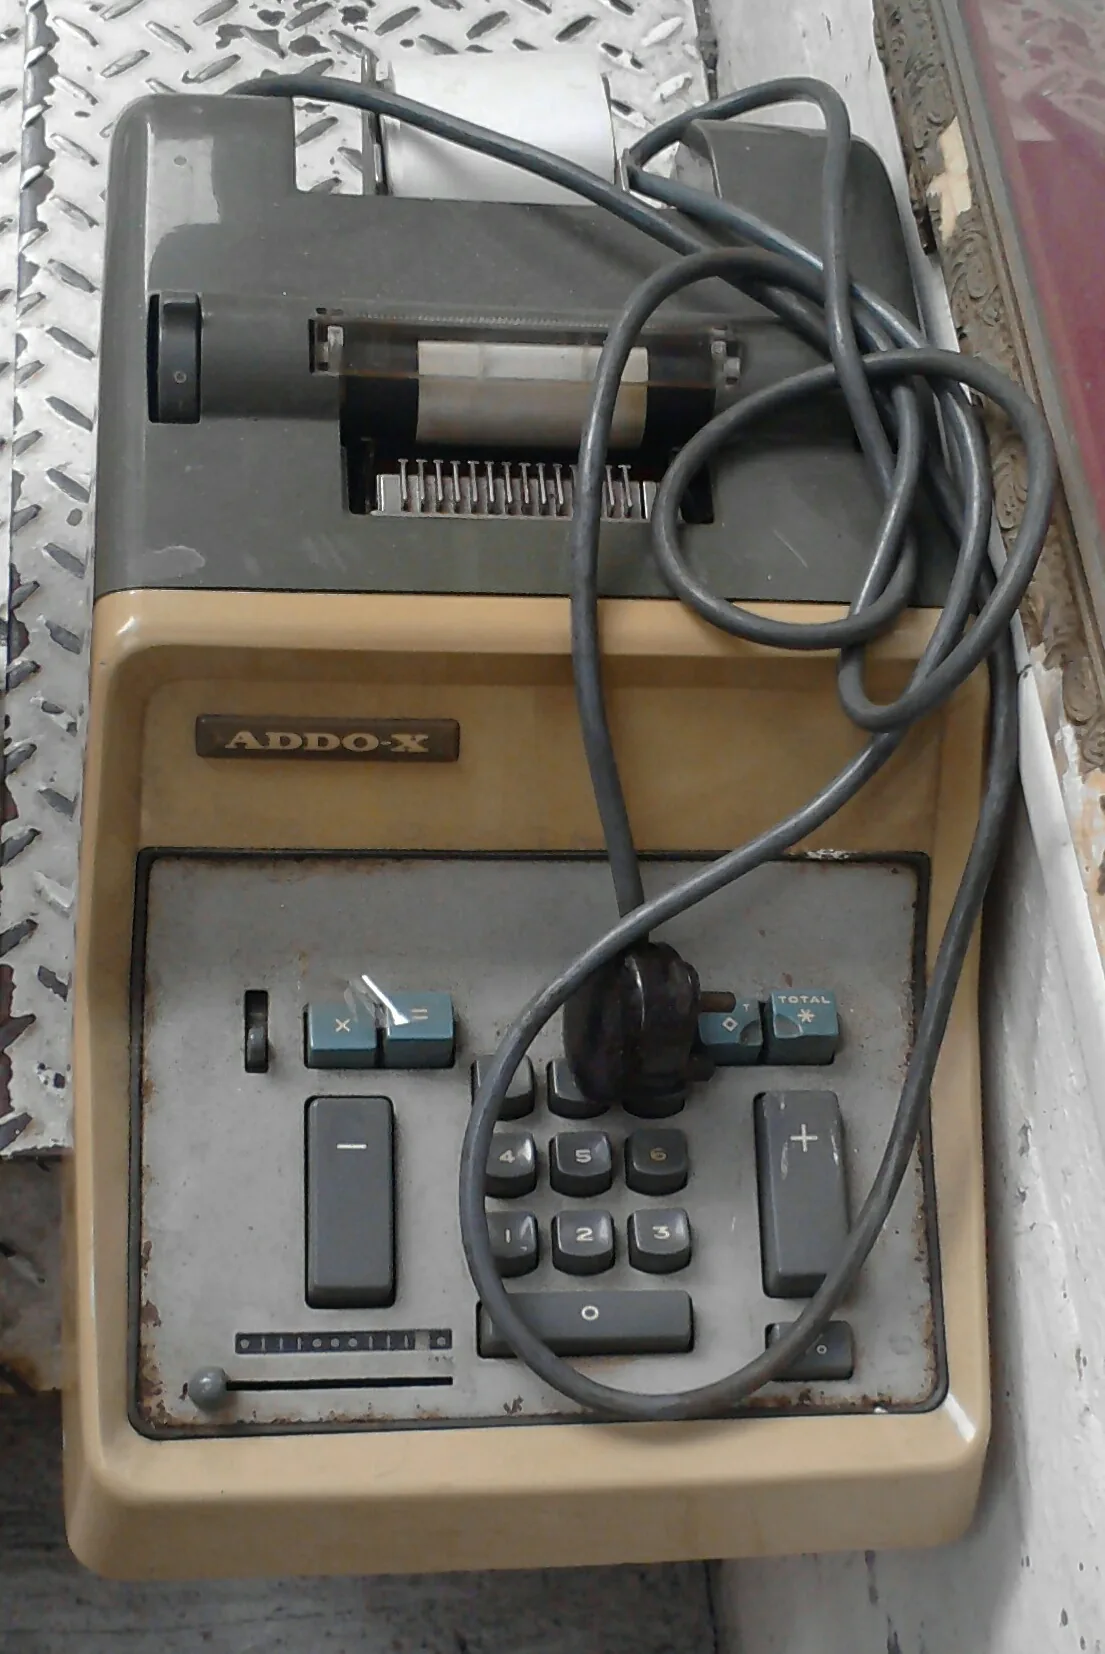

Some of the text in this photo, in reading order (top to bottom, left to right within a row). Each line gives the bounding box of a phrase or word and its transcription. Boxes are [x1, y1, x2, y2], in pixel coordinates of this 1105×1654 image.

[225, 731, 429, 752] ADDO-X
[778, 995, 831, 1004] TOTAL
[500, 1149, 515, 1163] 4
[575, 1149, 592, 1163] 5
[650, 1147, 667, 1161] 6
[505, 1228, 511, 1243] 1
[576, 1227, 594, 1242] 2
[652, 1225, 670, 1240] 3
